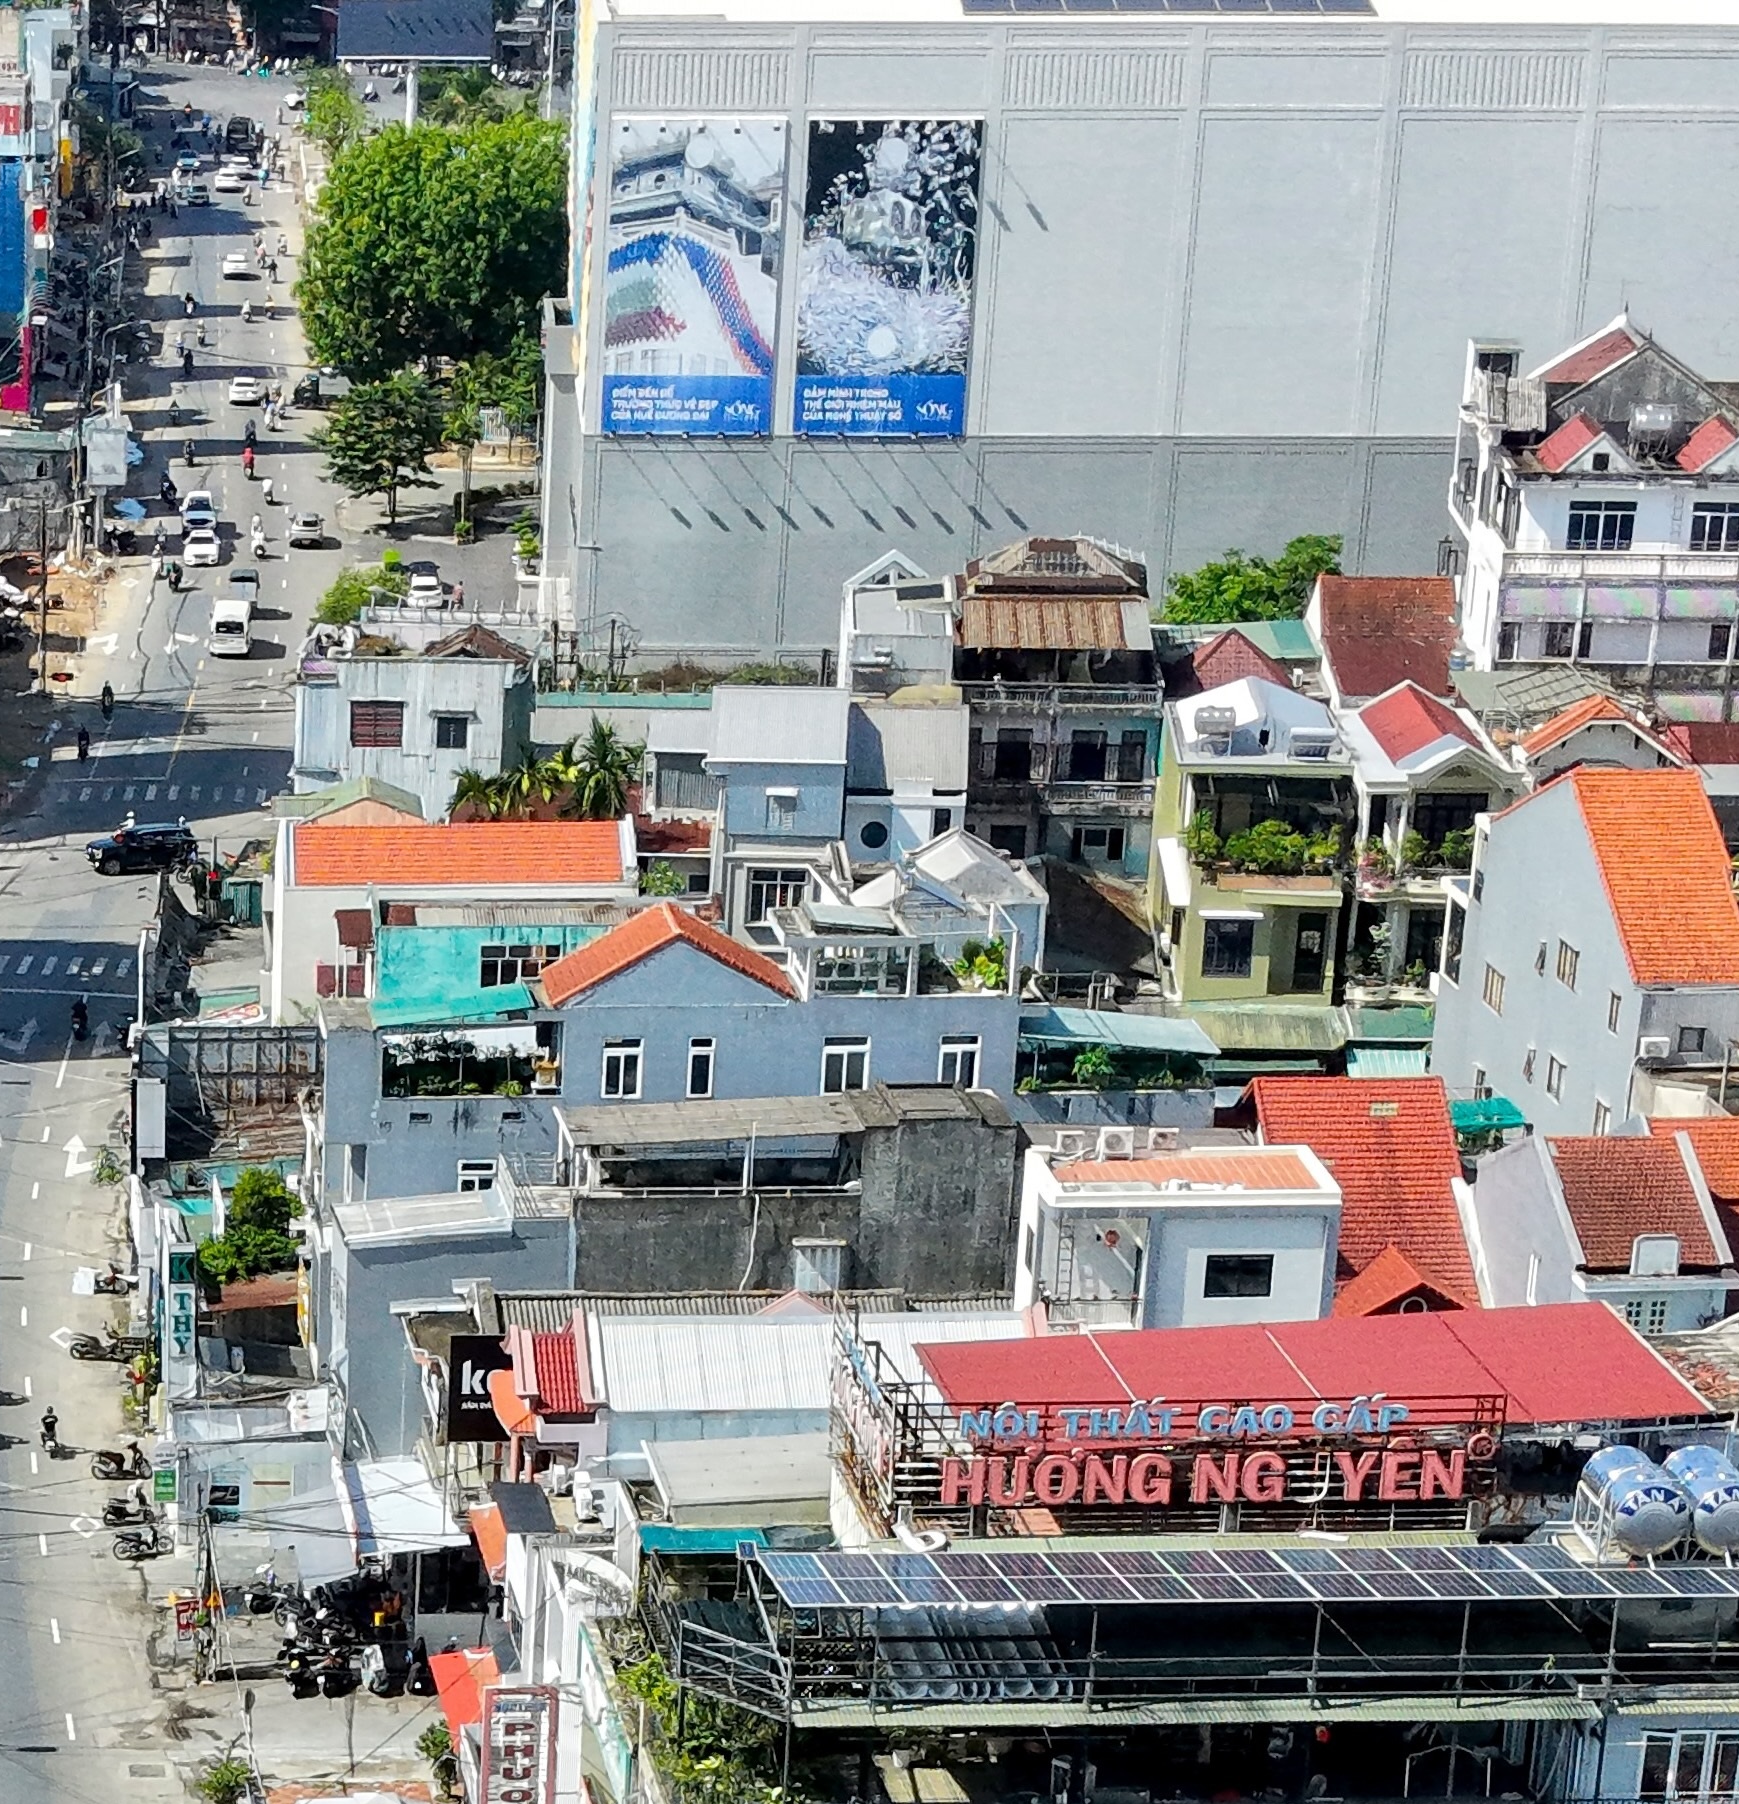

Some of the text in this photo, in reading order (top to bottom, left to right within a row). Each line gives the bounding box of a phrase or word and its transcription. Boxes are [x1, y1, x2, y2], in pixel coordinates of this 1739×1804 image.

[172, 1292, 193, 1355] THY
[1058, 1397, 1182, 1440] THẤT
[1198, 1404, 1295, 1435] CAO
[1312, 1392, 1410, 1434] CẤP
